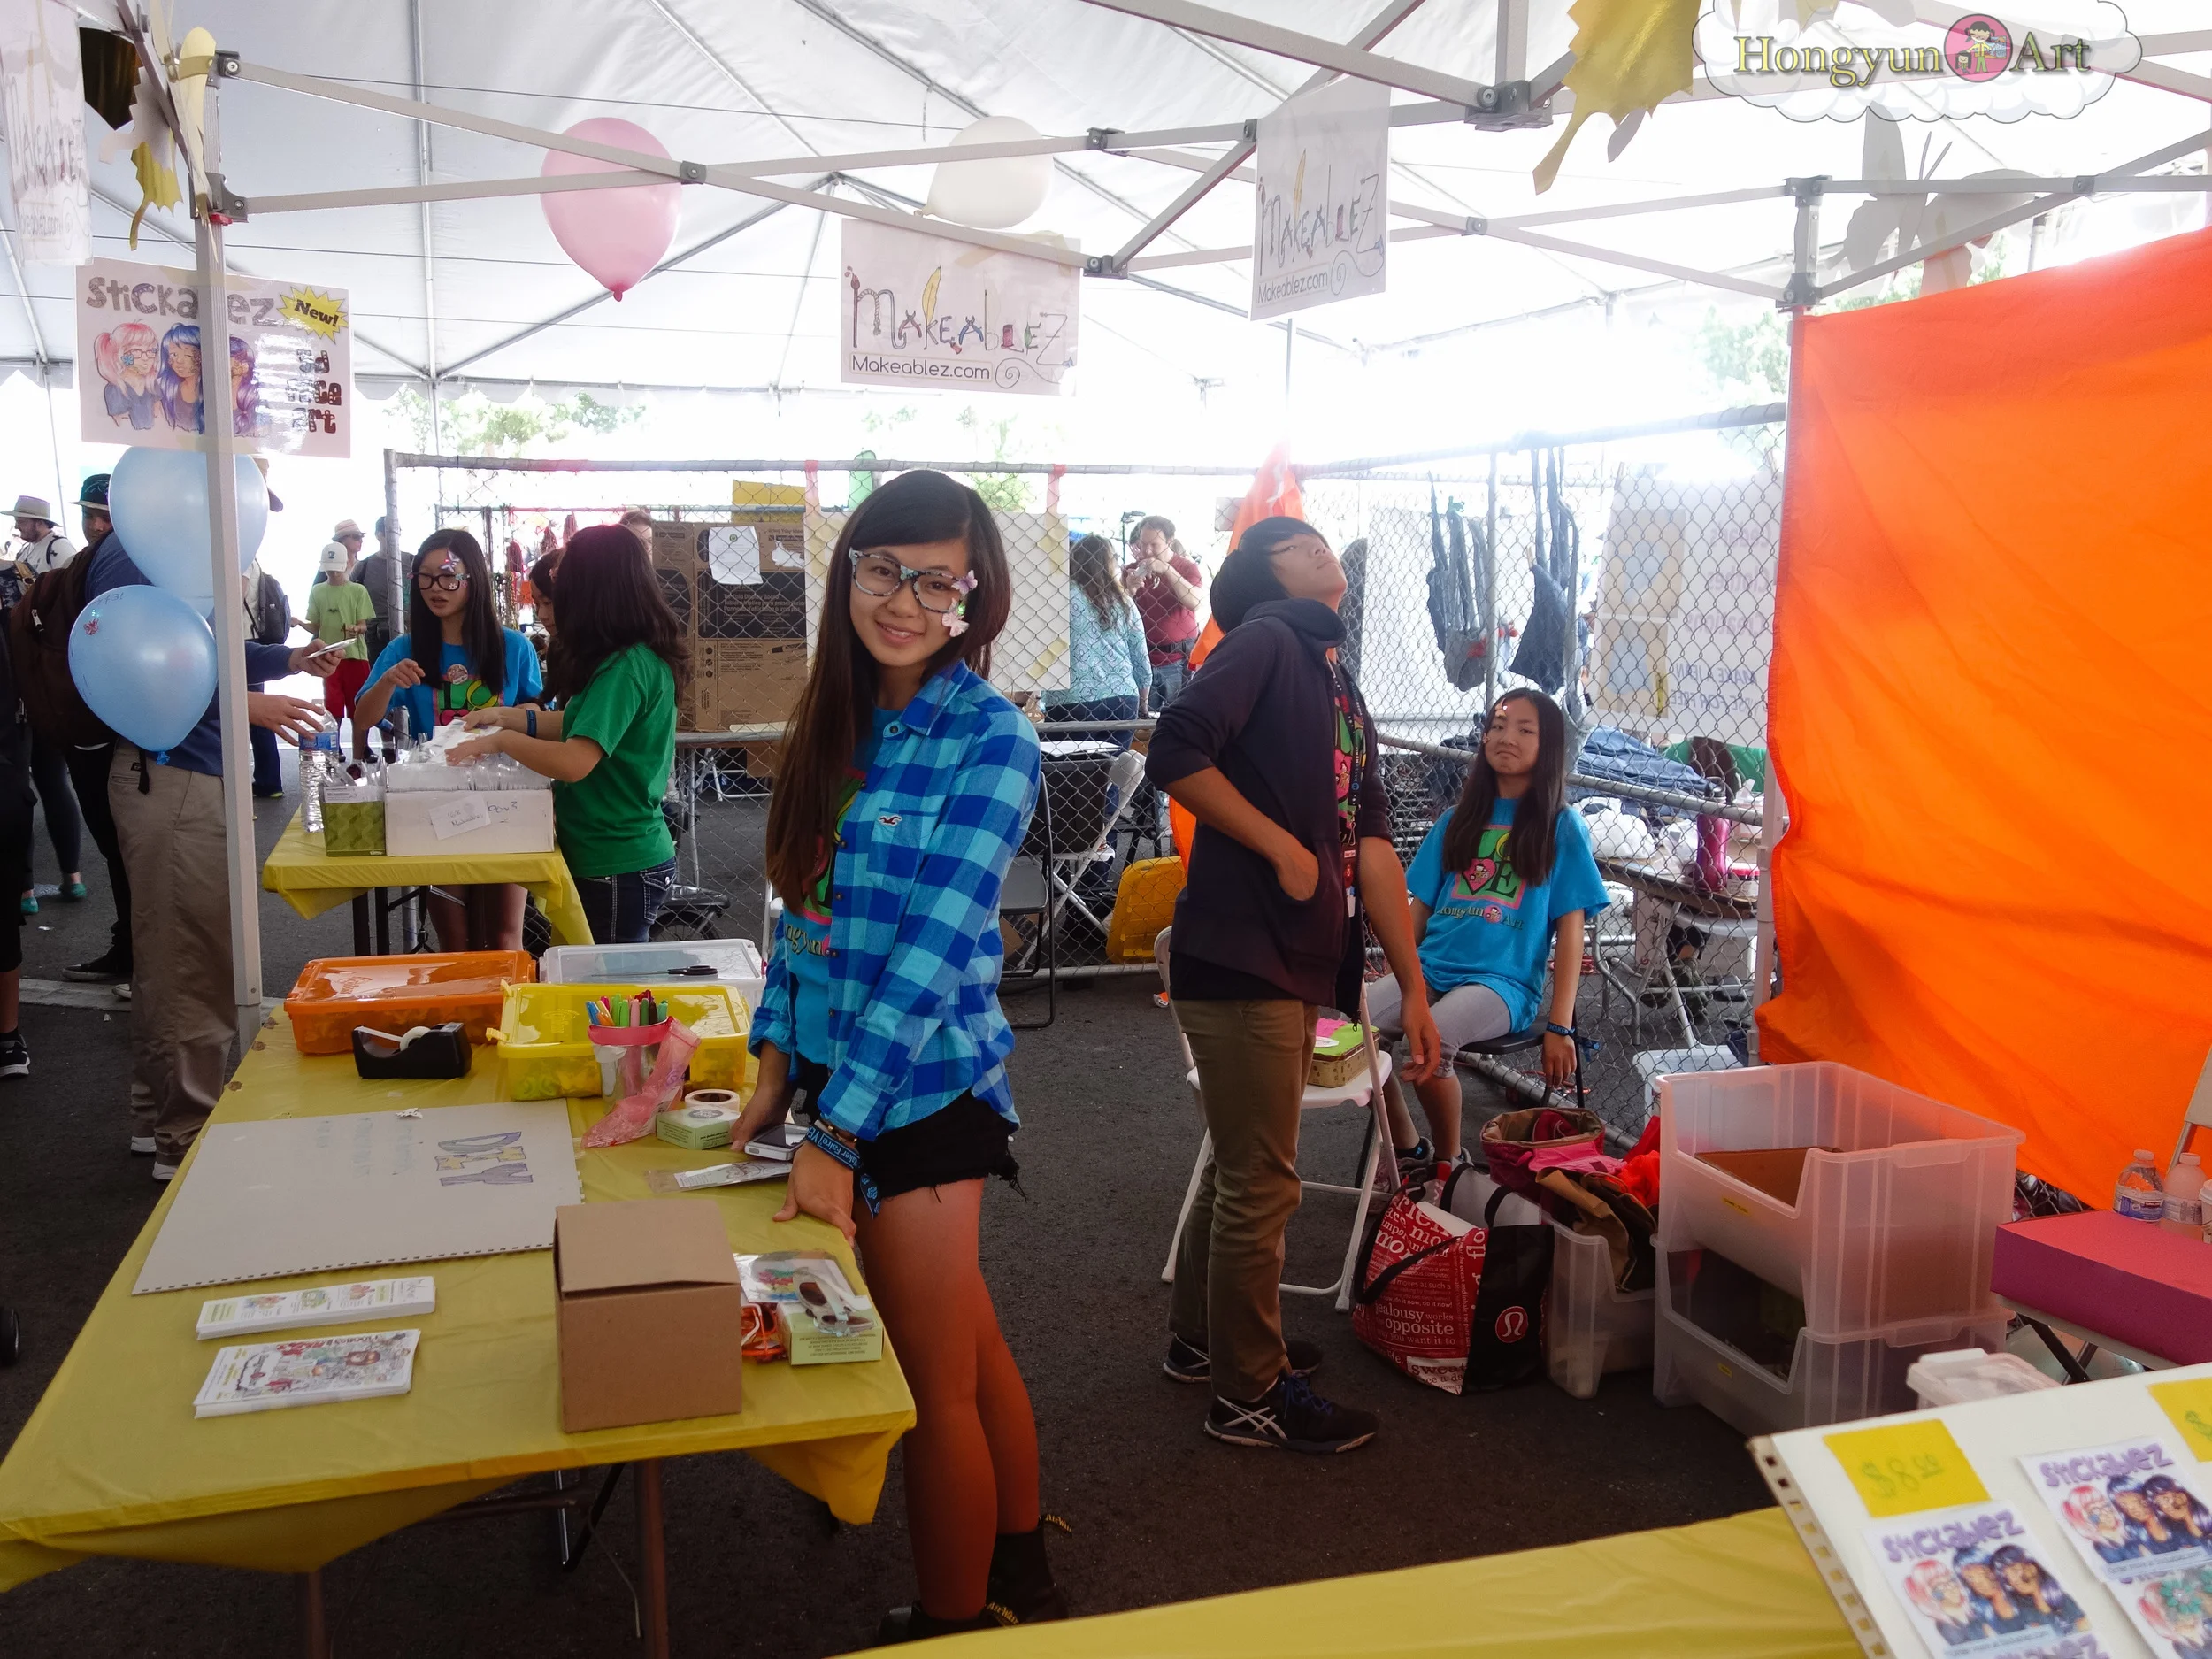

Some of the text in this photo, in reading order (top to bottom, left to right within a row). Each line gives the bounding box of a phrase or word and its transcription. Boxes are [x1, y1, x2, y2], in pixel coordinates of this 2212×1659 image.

[1257, 271, 1328, 303] Makeablez.com
[293, 298, 340, 327] New!
[852, 354, 991, 380] Makeablez.com
[434, 1131, 534, 1187] DIY
[1385, 1317, 1455, 1336] opposite
